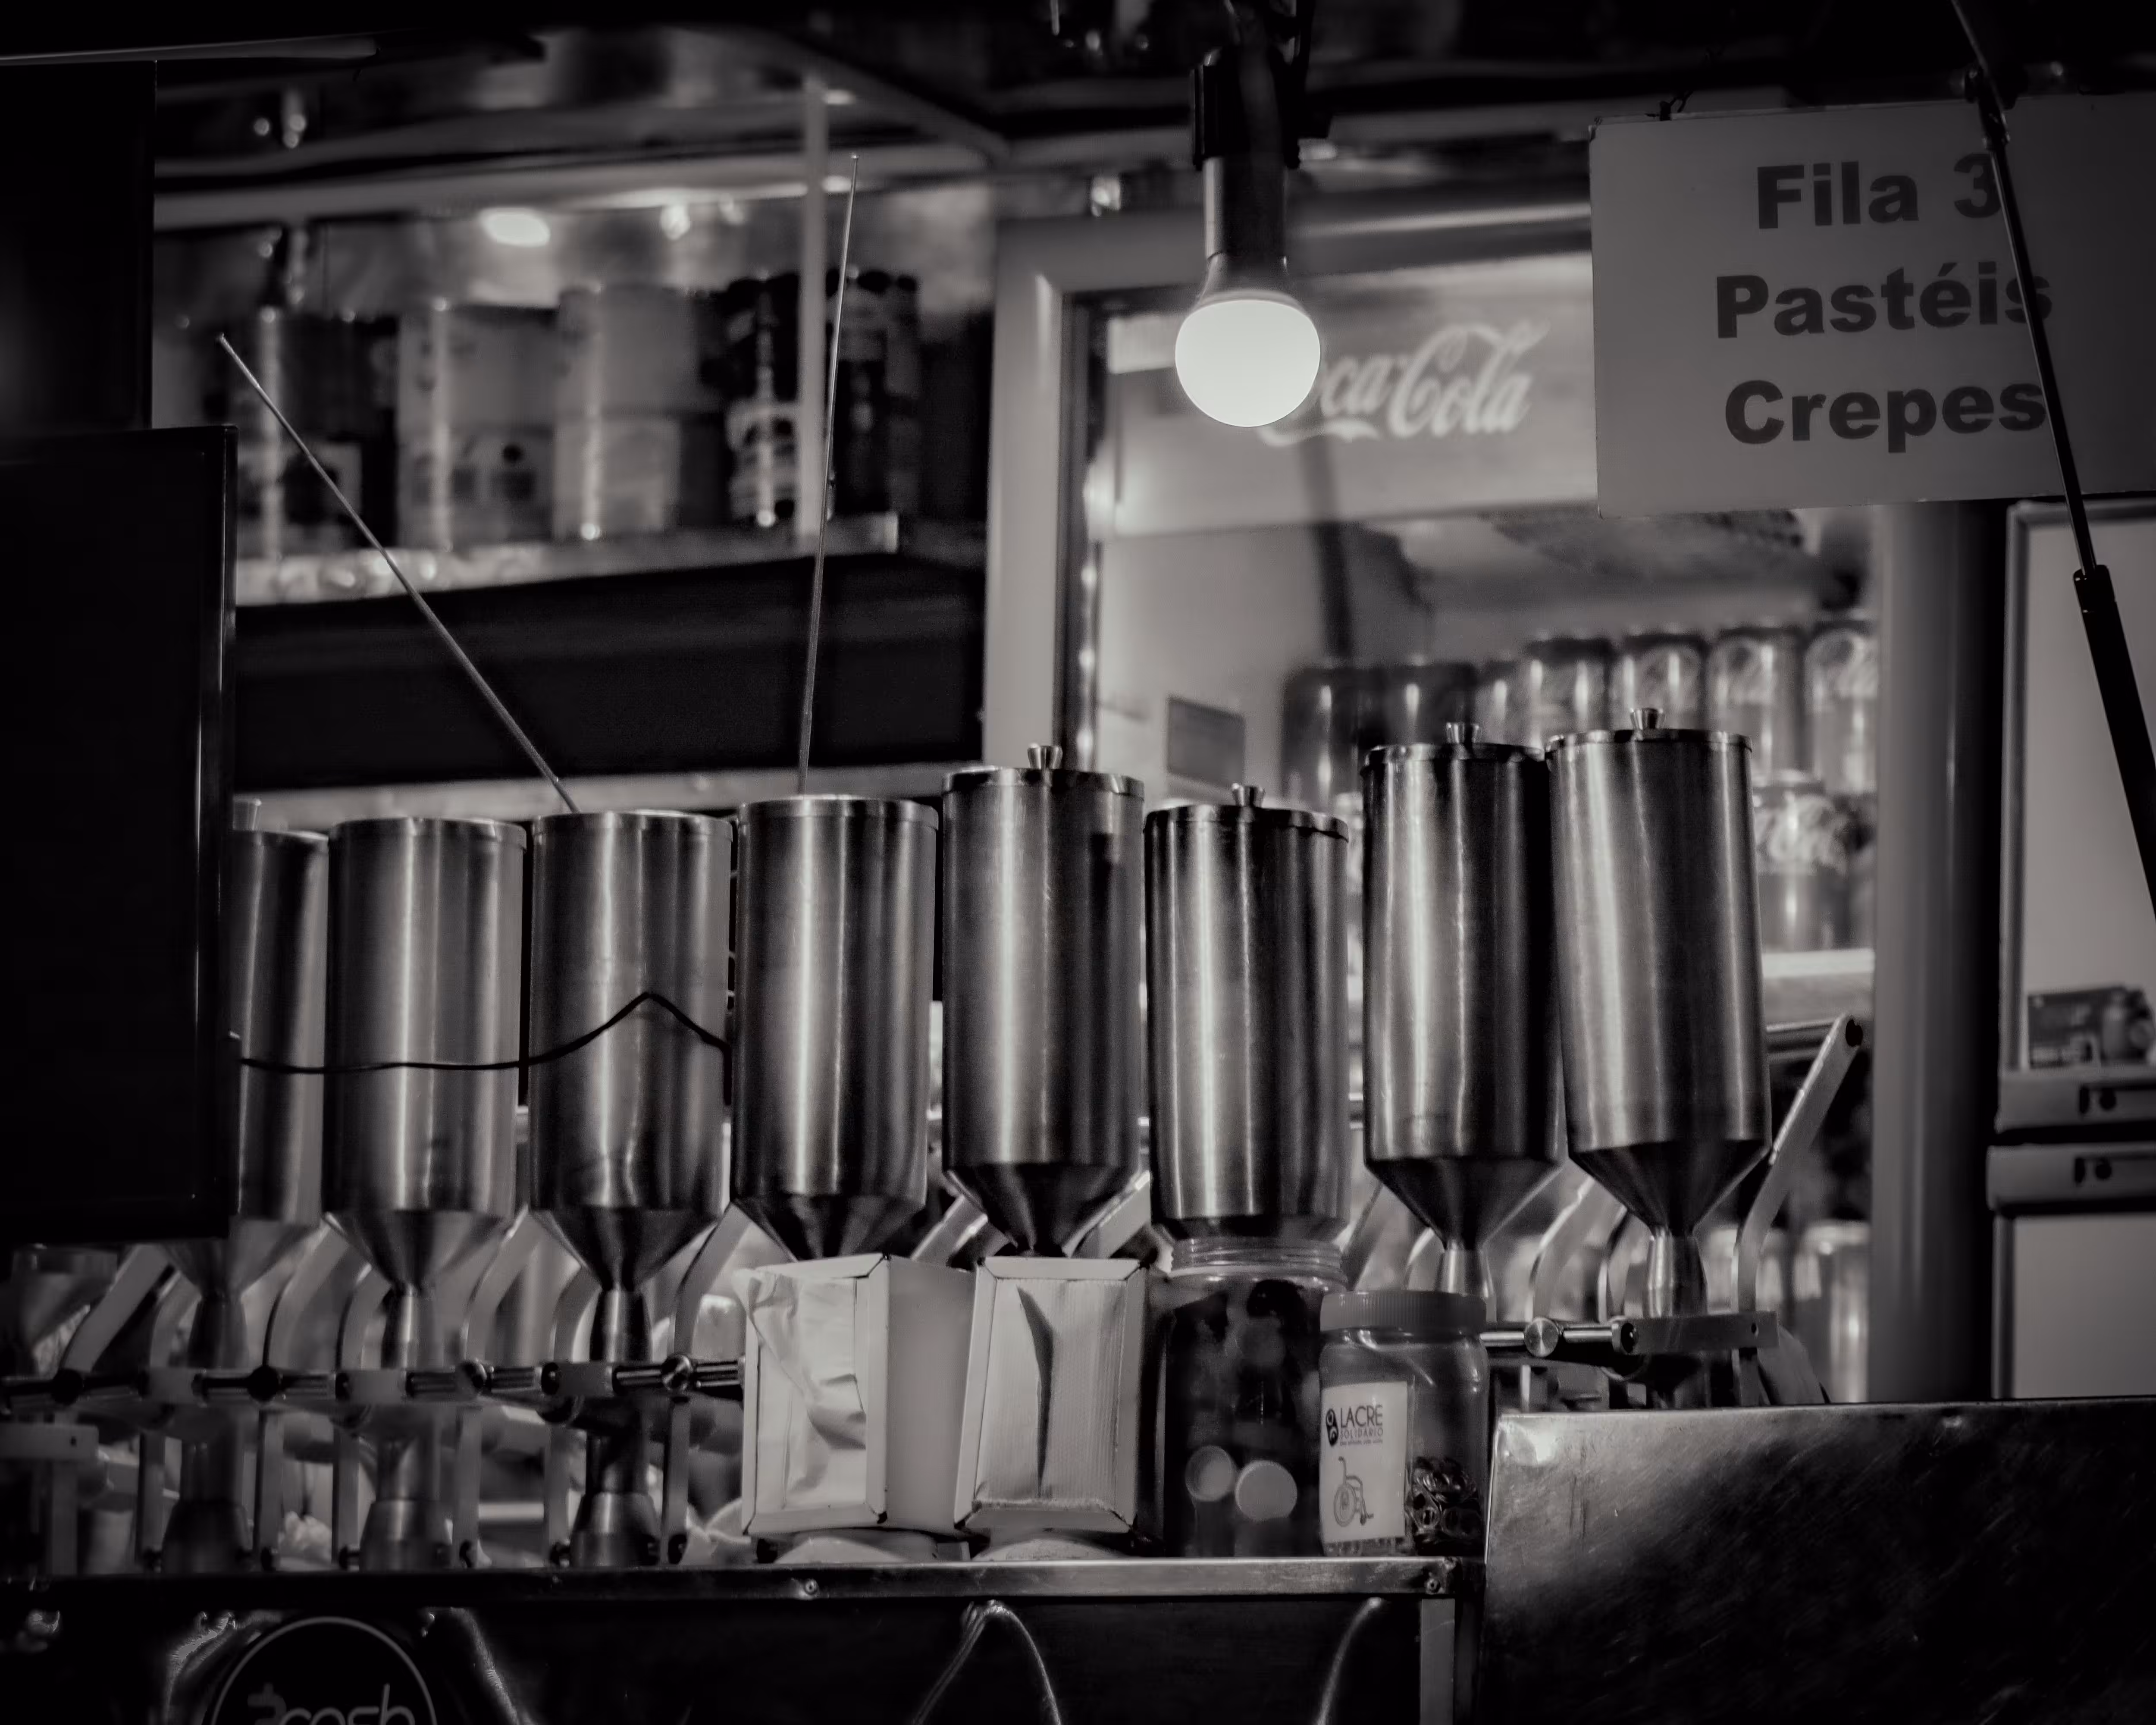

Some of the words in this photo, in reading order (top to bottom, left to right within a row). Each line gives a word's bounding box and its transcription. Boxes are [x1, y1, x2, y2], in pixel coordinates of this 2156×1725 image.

[1757, 161, 1918, 229] Fila
[1954, 153, 2002, 218] 3
[1717, 261, 2052, 339] Pastéis
[1725, 380, 2046, 453] Crepes
[1340, 1405, 1383, 1429] LACRE
